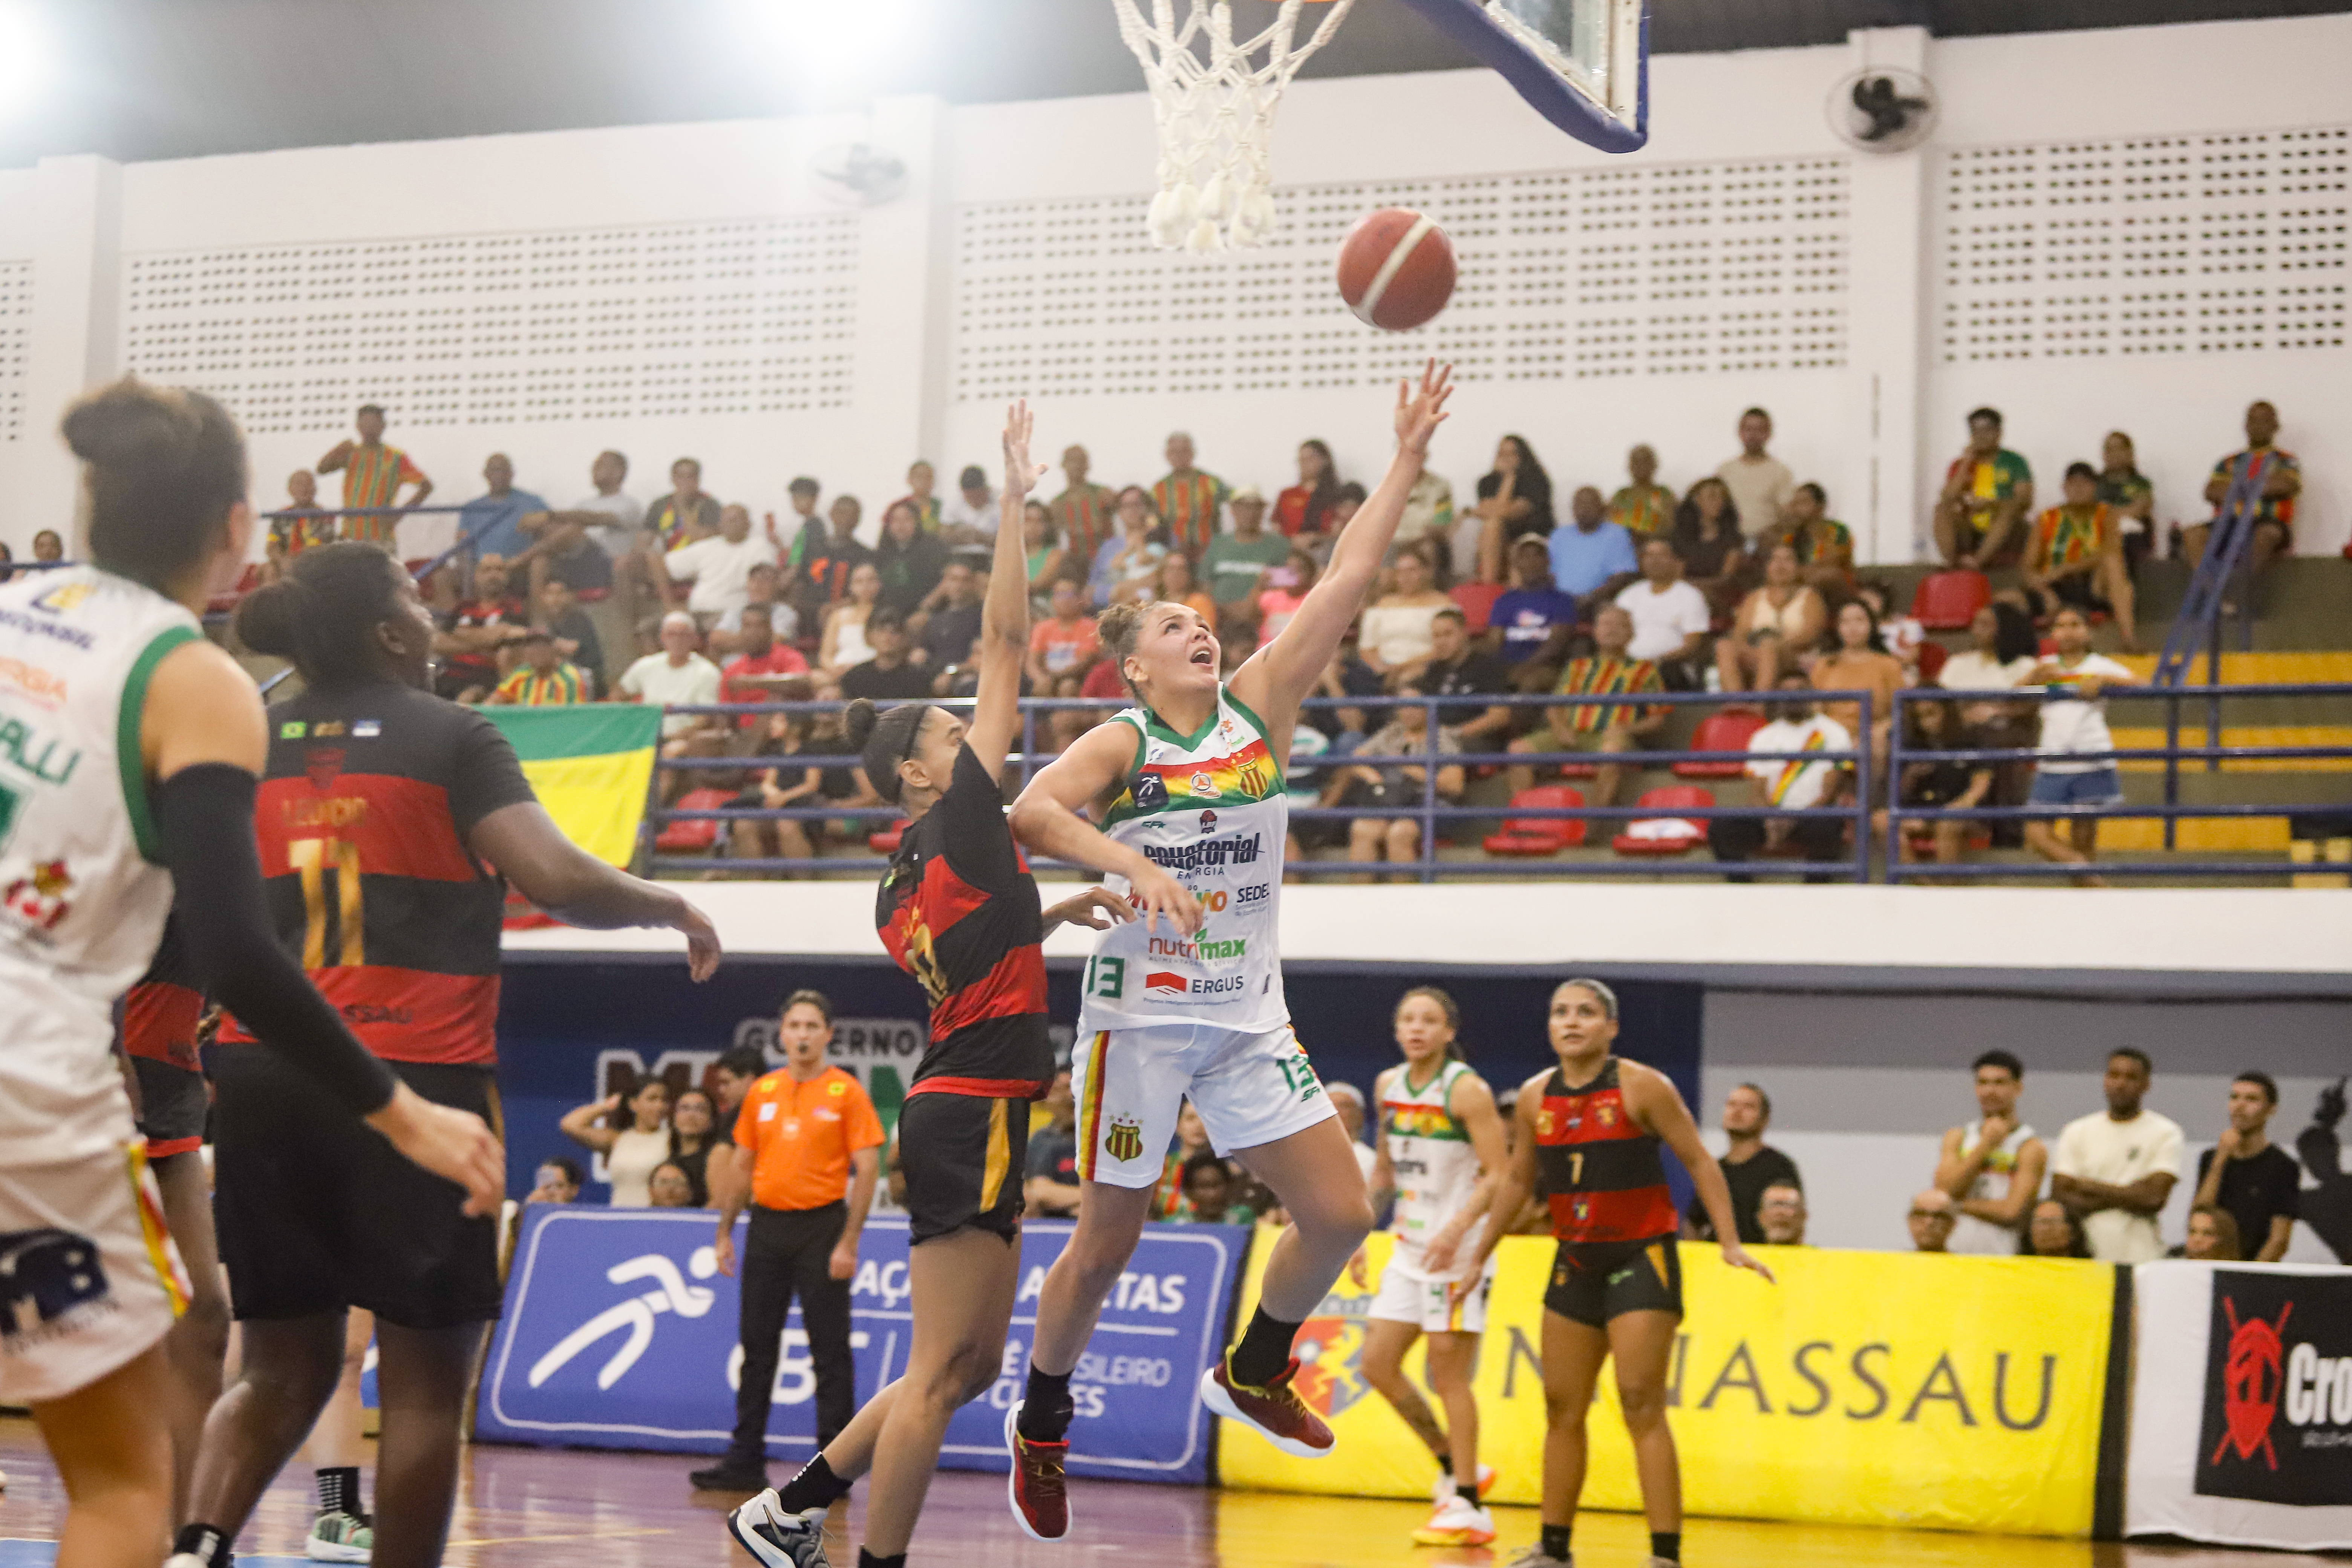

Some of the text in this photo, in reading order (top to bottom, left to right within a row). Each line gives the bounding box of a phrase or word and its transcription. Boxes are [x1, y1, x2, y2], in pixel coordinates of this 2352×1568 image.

[1087, 954, 1124, 999] 13
[1192, 976, 1243, 993] ERGUS
[743, 1026, 918, 1057] GOERNO
[1276, 1054, 1314, 1093] 13
